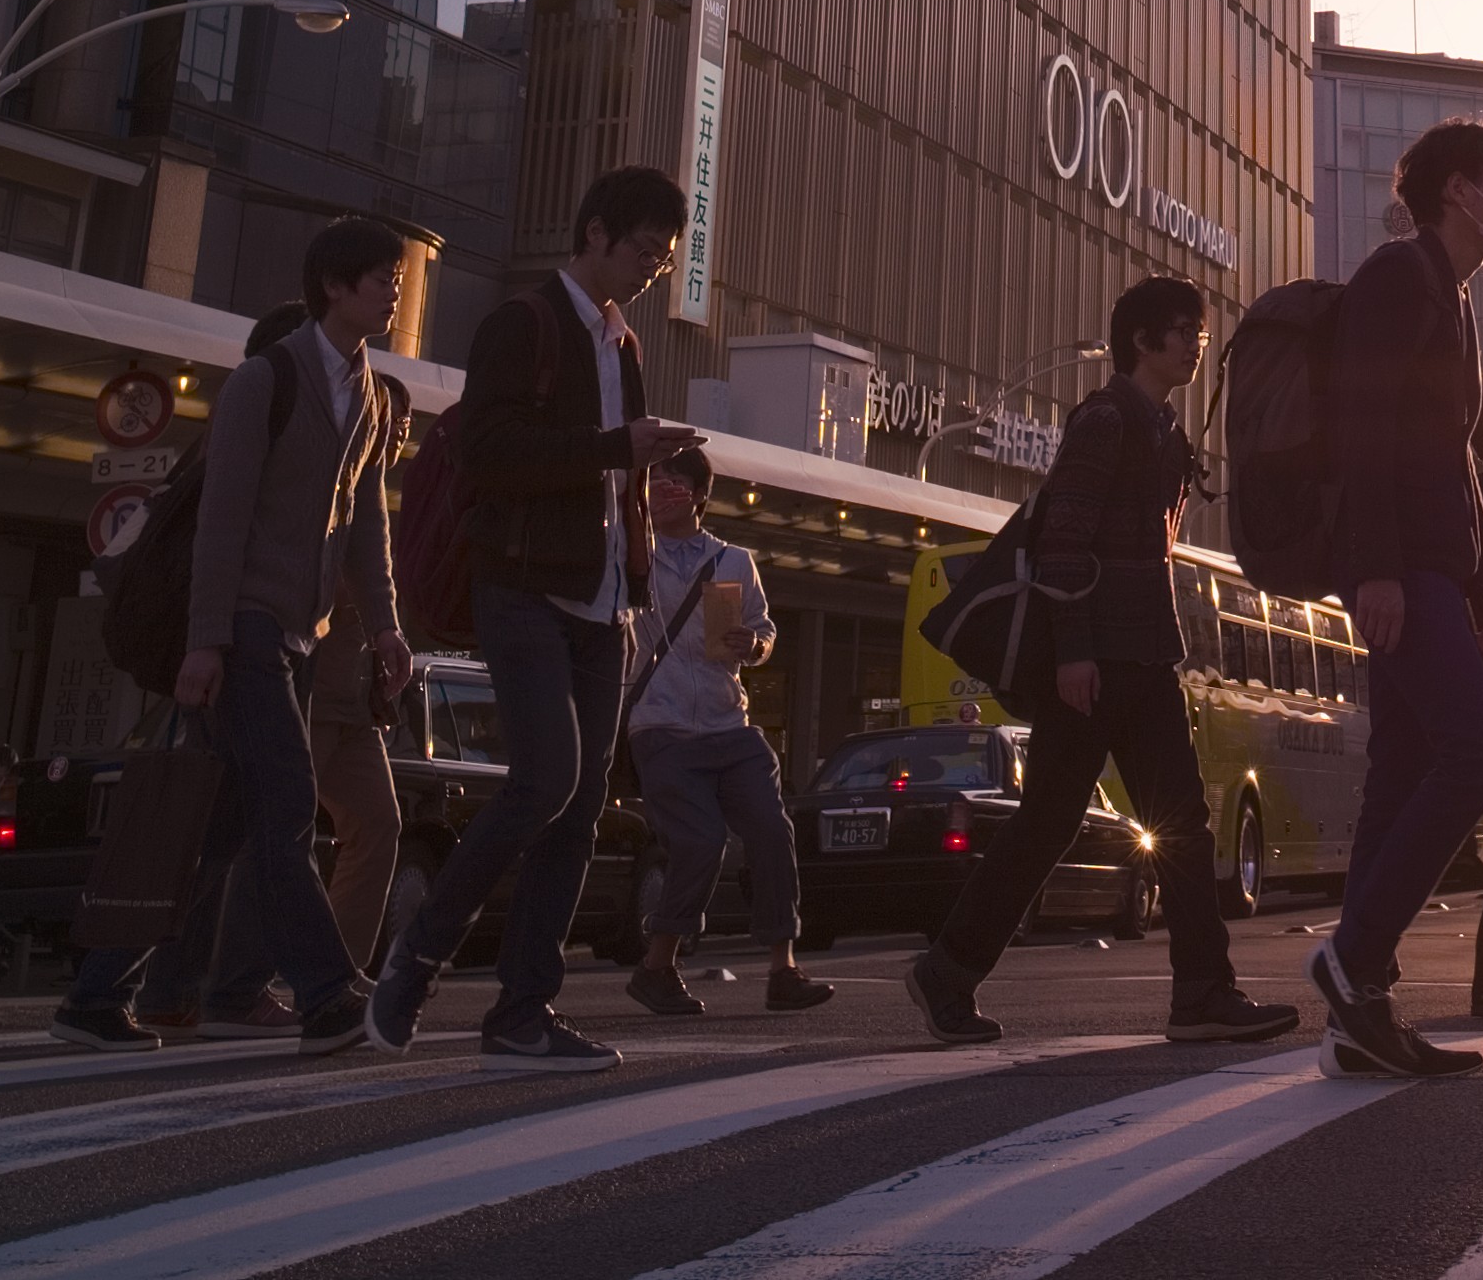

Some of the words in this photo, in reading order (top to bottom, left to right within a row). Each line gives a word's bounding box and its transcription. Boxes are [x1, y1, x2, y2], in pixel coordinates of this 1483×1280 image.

[687, 75, 716, 304] 三井住友銀行
[1149, 186, 1197, 249] KYOTO
[1198, 213, 1238, 273] MARUI
[1277, 718, 1318, 753] OSAKA
[1320, 723, 1345, 756] BUS
[842, 828, 877, 844] 40-57
